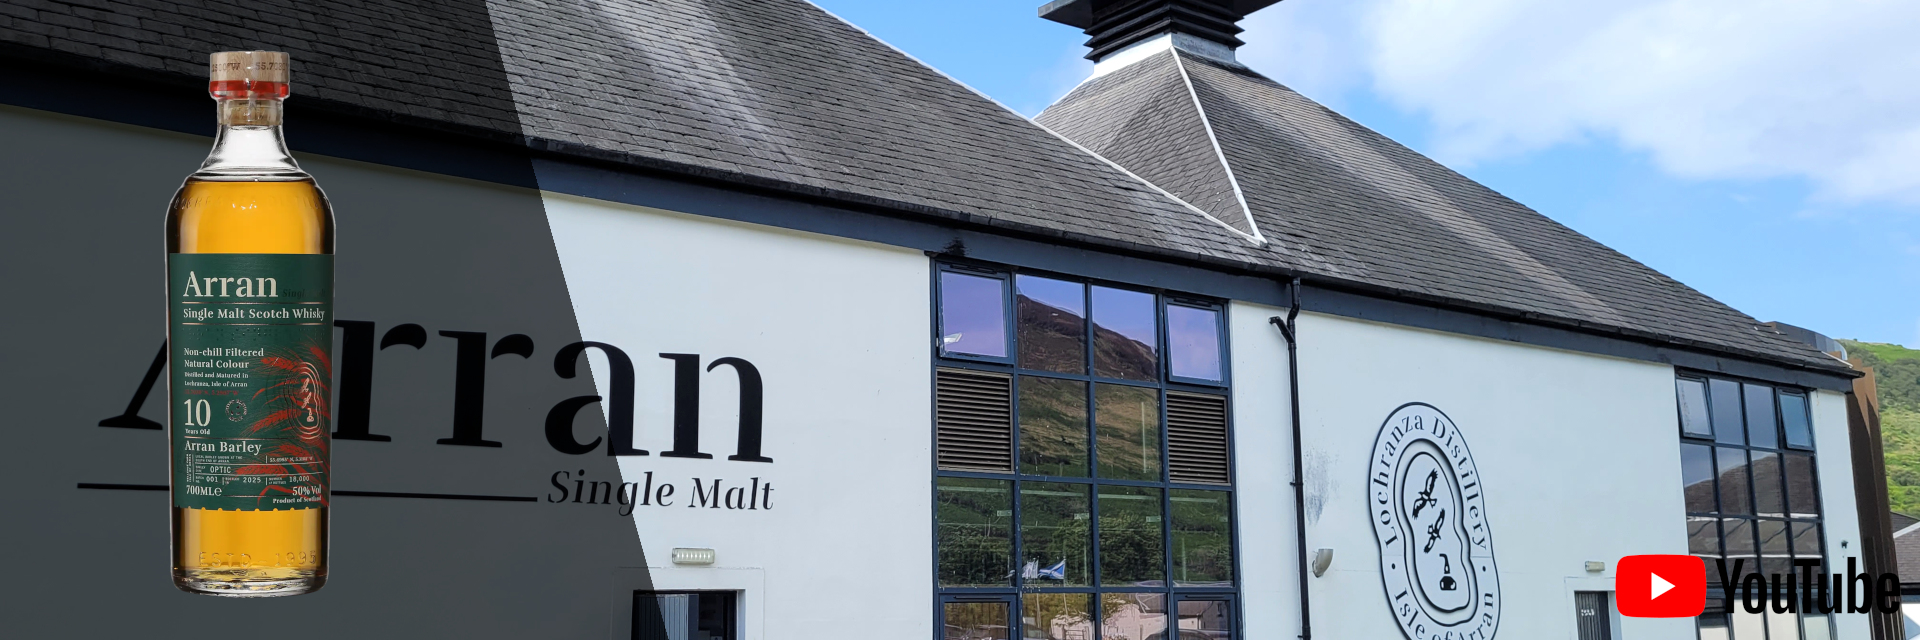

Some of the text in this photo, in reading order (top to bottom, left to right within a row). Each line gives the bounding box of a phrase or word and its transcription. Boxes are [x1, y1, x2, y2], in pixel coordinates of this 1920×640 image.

[183, 270, 279, 298] Arran
[183, 307, 325, 321] Single Malt Scotch Whisky
[184, 347, 264, 357] Non-chill Filtered
[184, 359, 250, 368] Natural Colour
[184, 398, 211, 427] 10
[184, 440, 262, 456] Arran Barley
[210, 465, 232, 474] OPTIC
[205, 475, 218, 483] 001
[242, 476, 262, 484] 2025
[289, 475, 310, 483] 18,000
[1373, 415, 1424, 548] Lochranza
[1431, 416, 1487, 550] Distillery
[292, 484, 322, 496] 50% Vol
[548, 469, 775, 516] Single Malt
[199, 550, 317, 568] ESTD 1995
[1394, 587, 1426, 640] Isle
